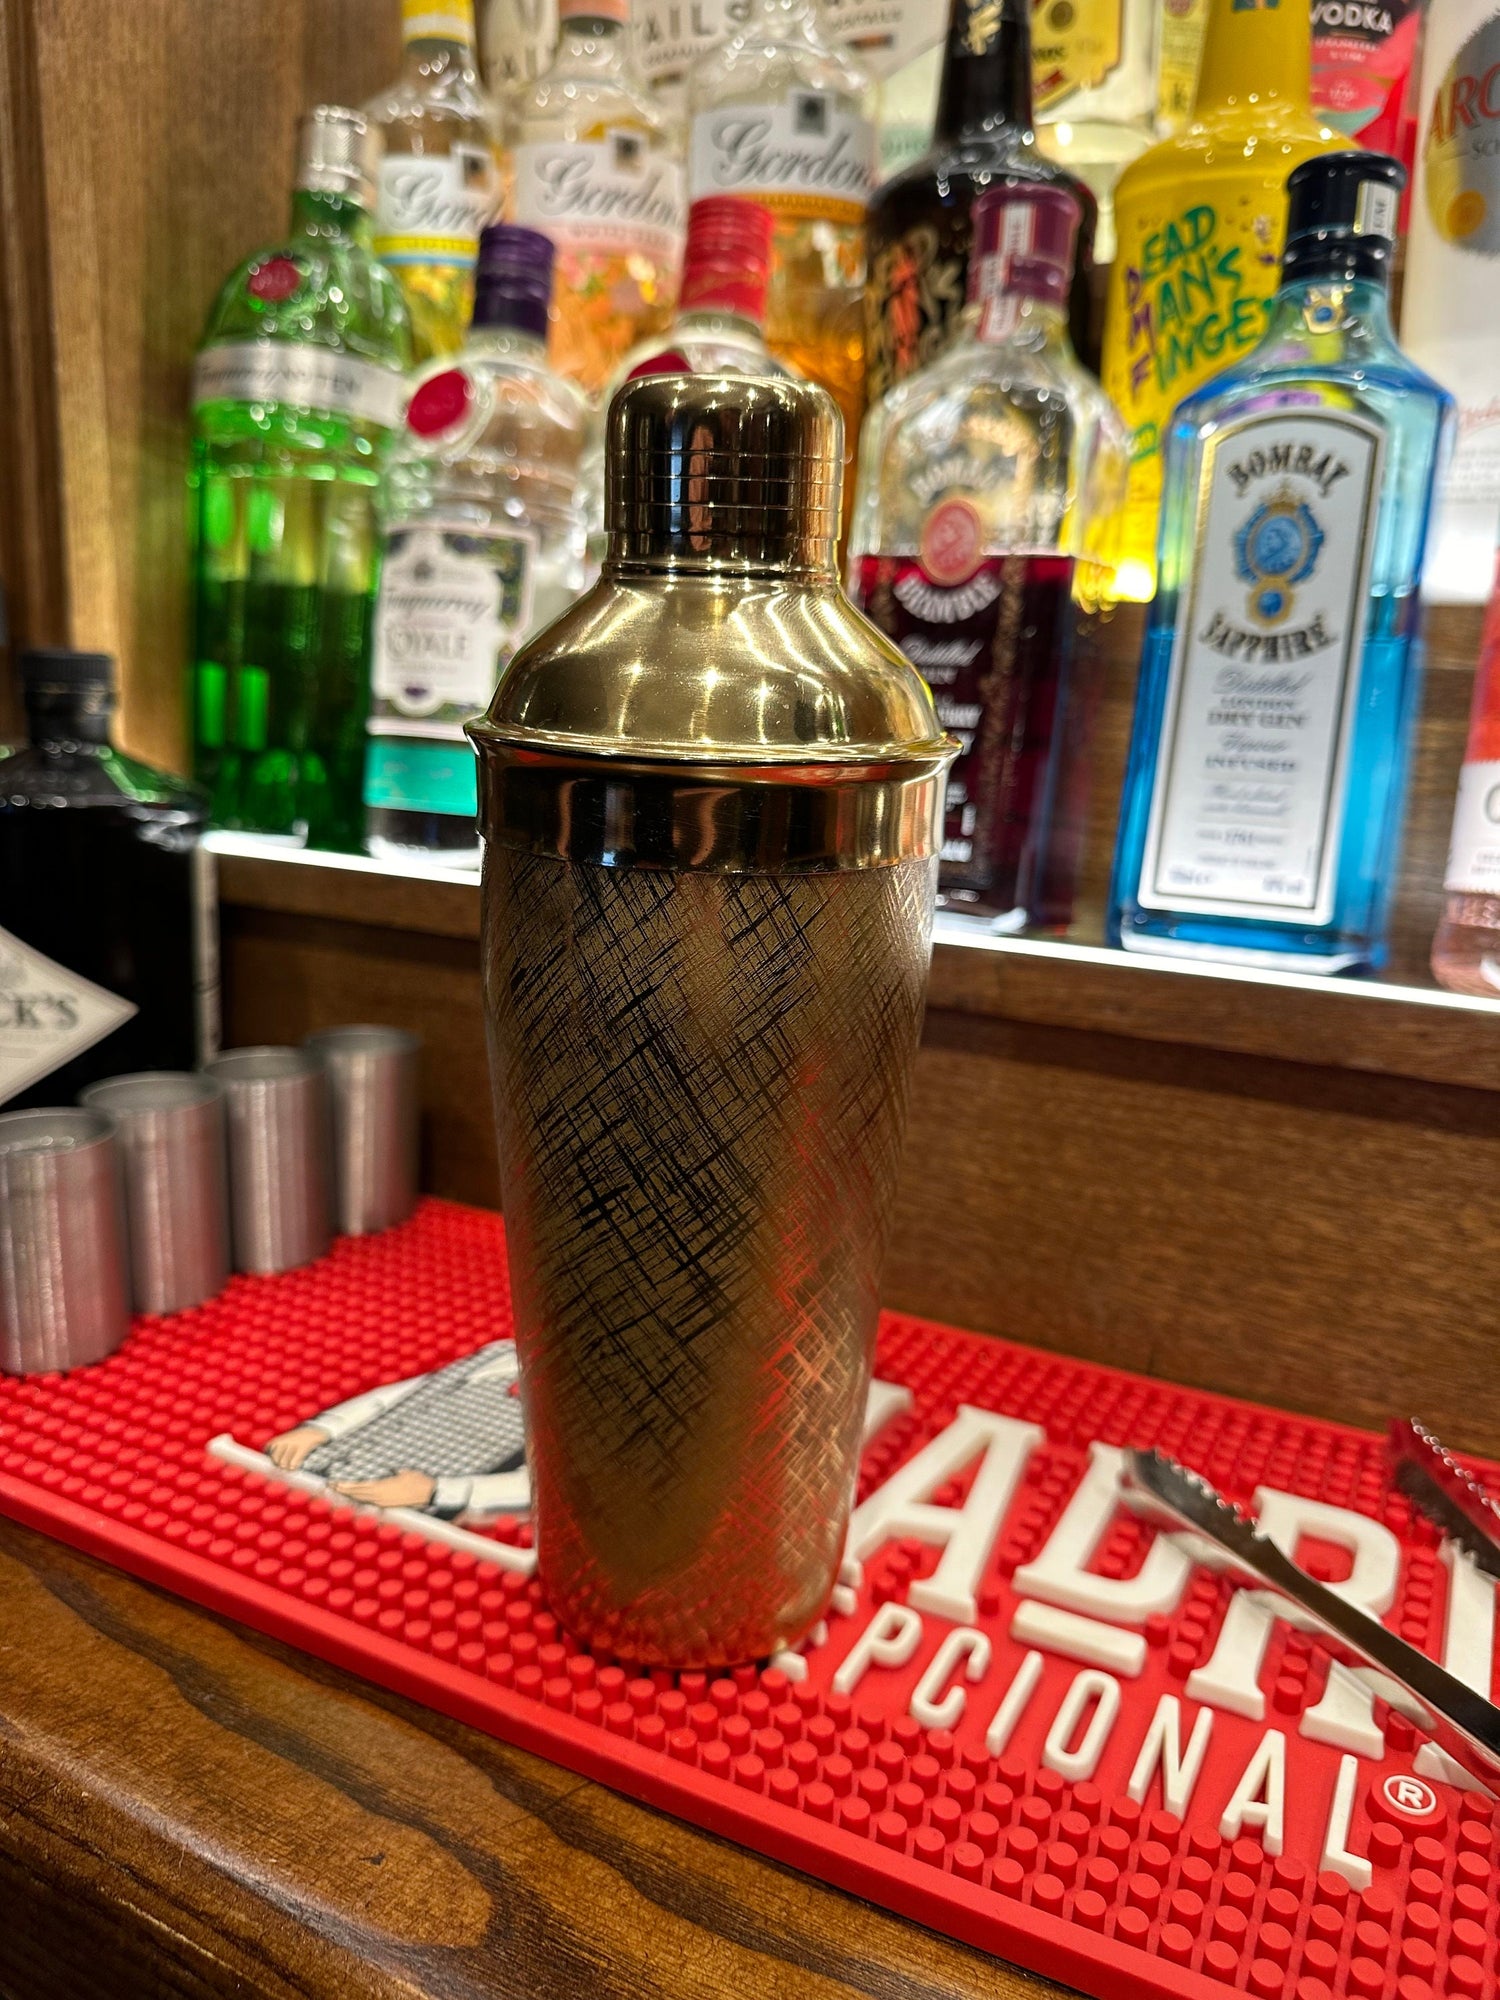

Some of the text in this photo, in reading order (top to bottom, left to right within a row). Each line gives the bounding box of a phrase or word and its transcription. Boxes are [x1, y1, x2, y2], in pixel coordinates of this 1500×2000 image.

[1310, 2, 1394, 34] VODKA
[1130, 297, 1274, 406] FINGE
[1226, 442, 1351, 498] BOMBAY
[1198, 608, 1340, 664] SAPPHIRE
[768, 1584, 1373, 1893] PCIONAL
